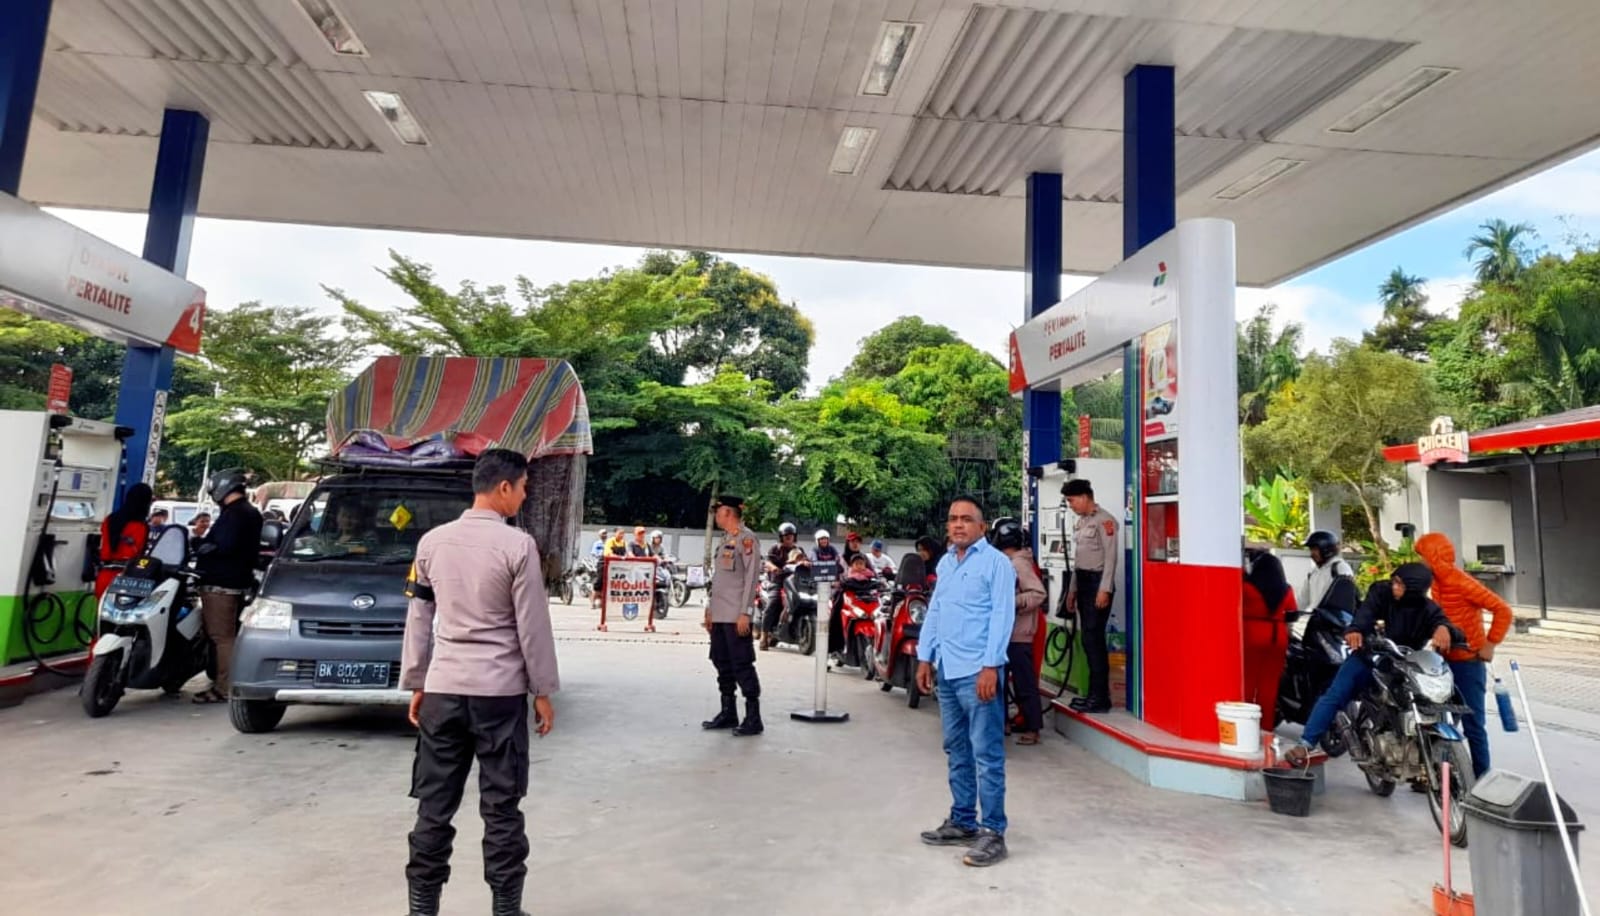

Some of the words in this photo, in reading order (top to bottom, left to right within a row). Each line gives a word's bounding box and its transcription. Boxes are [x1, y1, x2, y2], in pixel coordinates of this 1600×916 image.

[67, 275, 131, 314] PERTALITE
[189, 305, 200, 335] 4
[1049, 330, 1085, 361] PERTALITE
[1418, 432, 1463, 455] CHICKEN
[319, 663, 333, 678] BK
[337, 663, 367, 678] 8027
